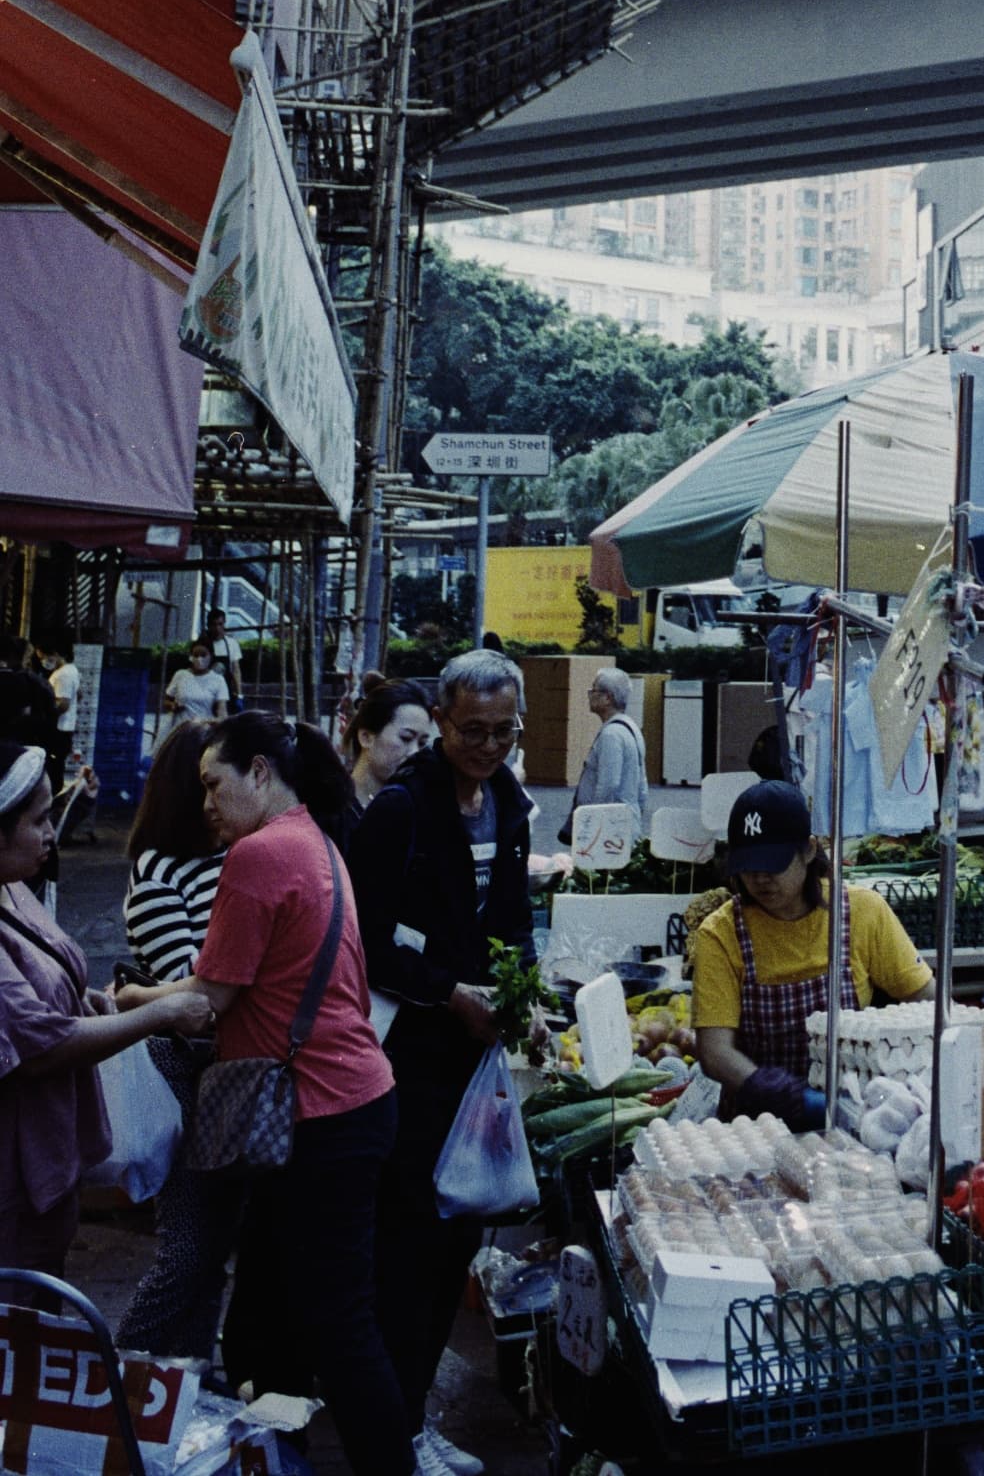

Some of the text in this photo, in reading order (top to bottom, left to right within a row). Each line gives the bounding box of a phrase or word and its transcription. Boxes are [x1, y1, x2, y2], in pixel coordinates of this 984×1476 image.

[440, 437, 546, 451] Shamchun Street
[468, 455, 518, 469] 深圳街
[744, 811, 763, 836] NY
